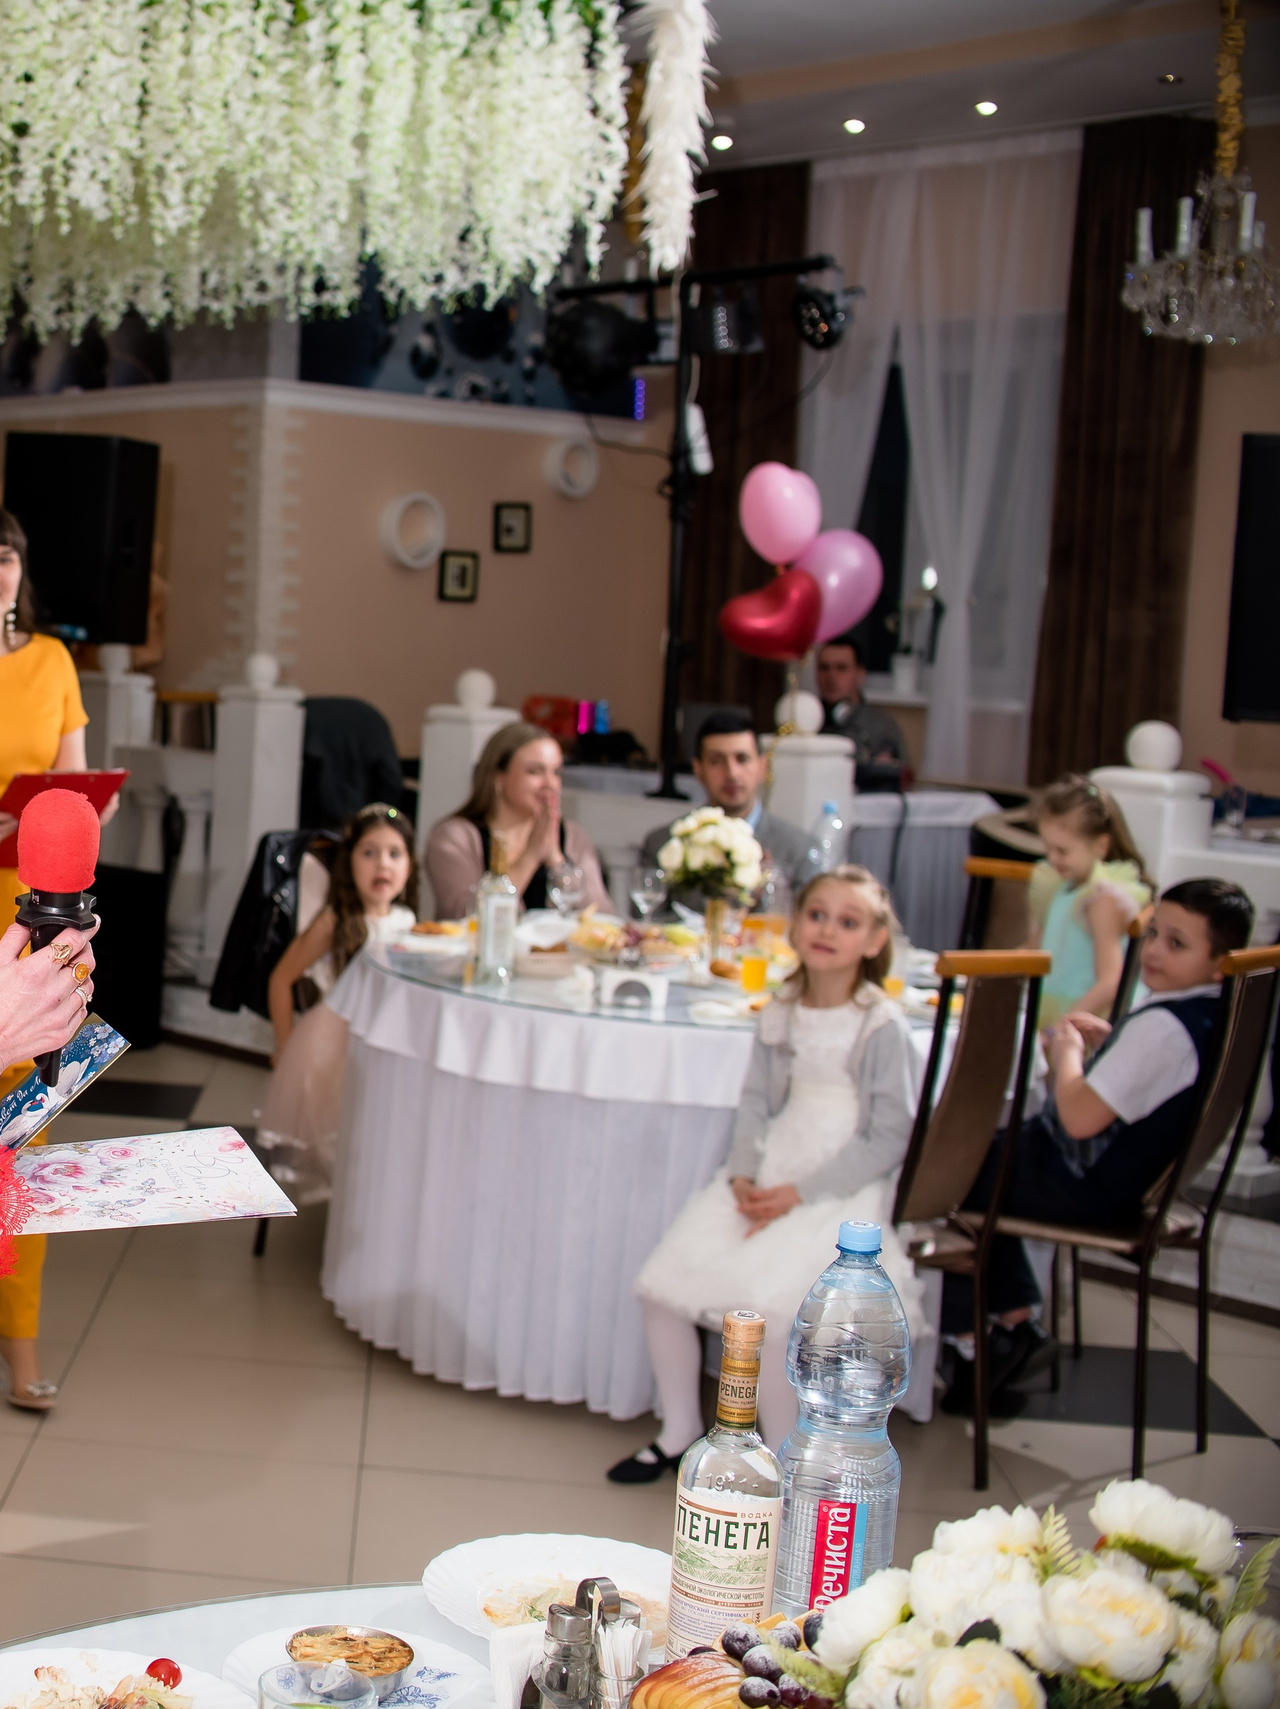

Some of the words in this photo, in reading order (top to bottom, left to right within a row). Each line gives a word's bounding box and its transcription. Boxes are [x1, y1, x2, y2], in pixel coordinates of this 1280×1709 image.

[720, 1381, 757, 1399] PENEGA
[677, 1504, 770, 1550] ПЕНЕГА
[740, 1511, 773, 1519] ВОДКА
[852, 1543, 863, 1590] ИРОВАННАЯ
